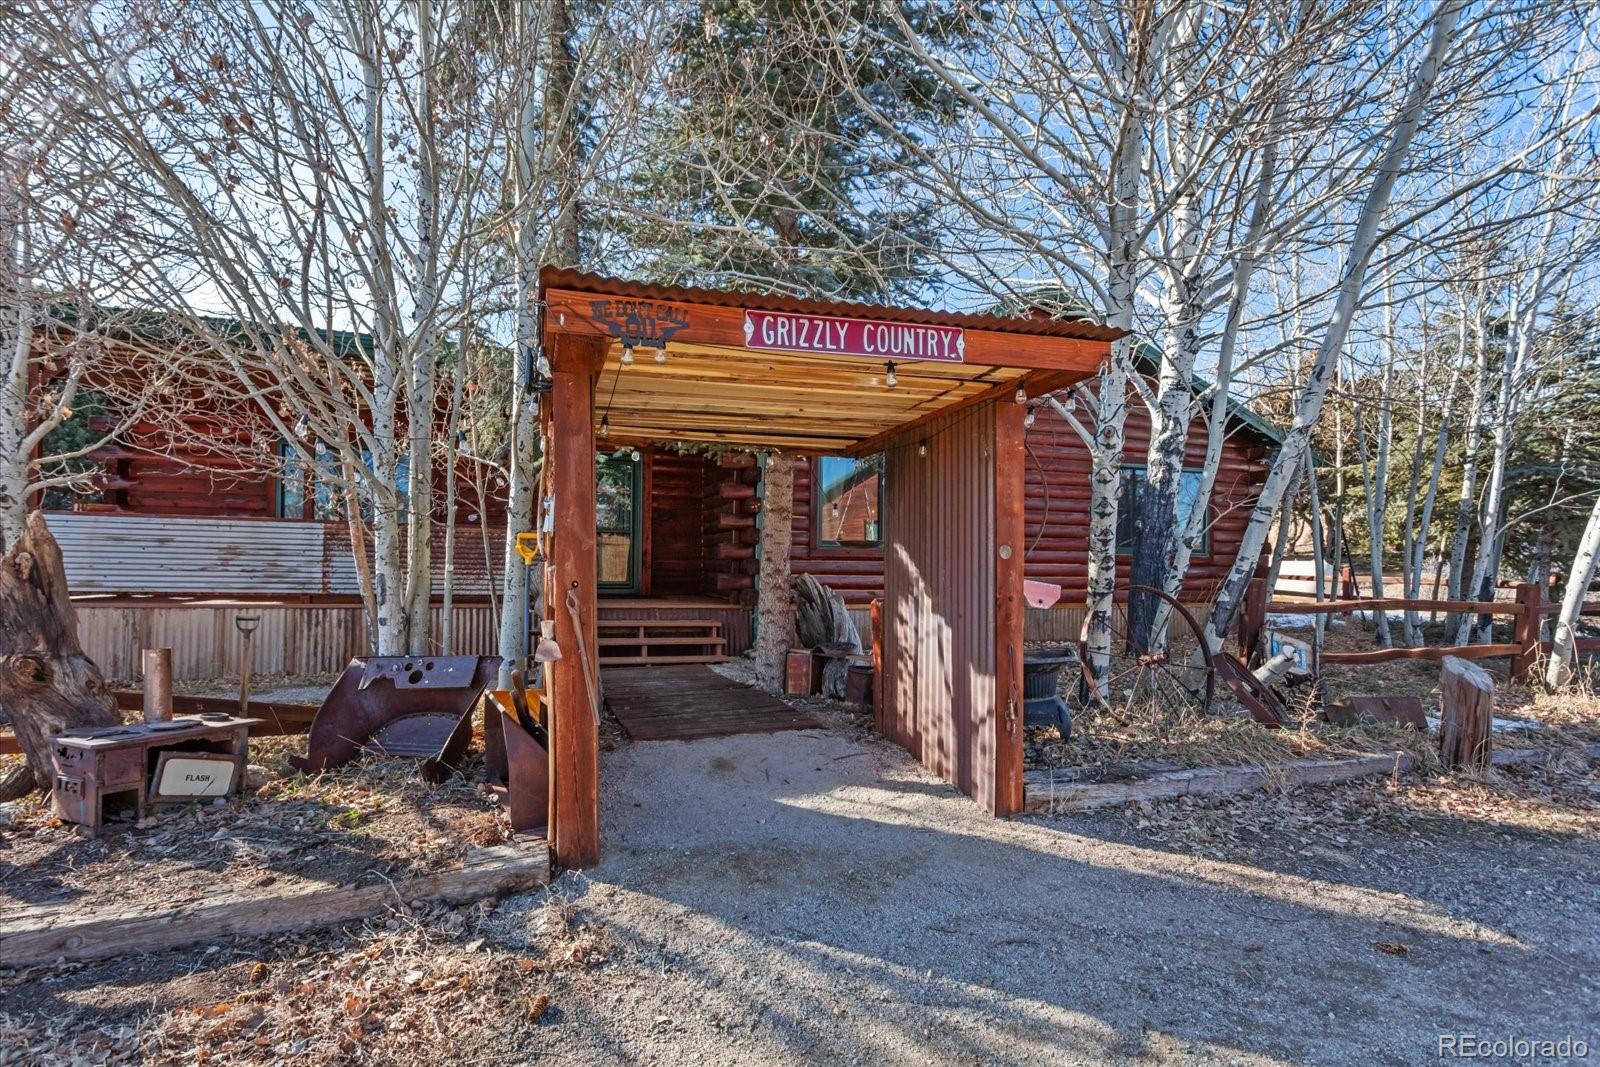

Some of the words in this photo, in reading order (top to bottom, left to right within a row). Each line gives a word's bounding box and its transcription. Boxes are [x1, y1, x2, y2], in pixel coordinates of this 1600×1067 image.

[762, 315, 849, 350] GRIZZLY
[863, 324, 953, 357] COUNTRY
[185, 774, 211, 782] FLASH
